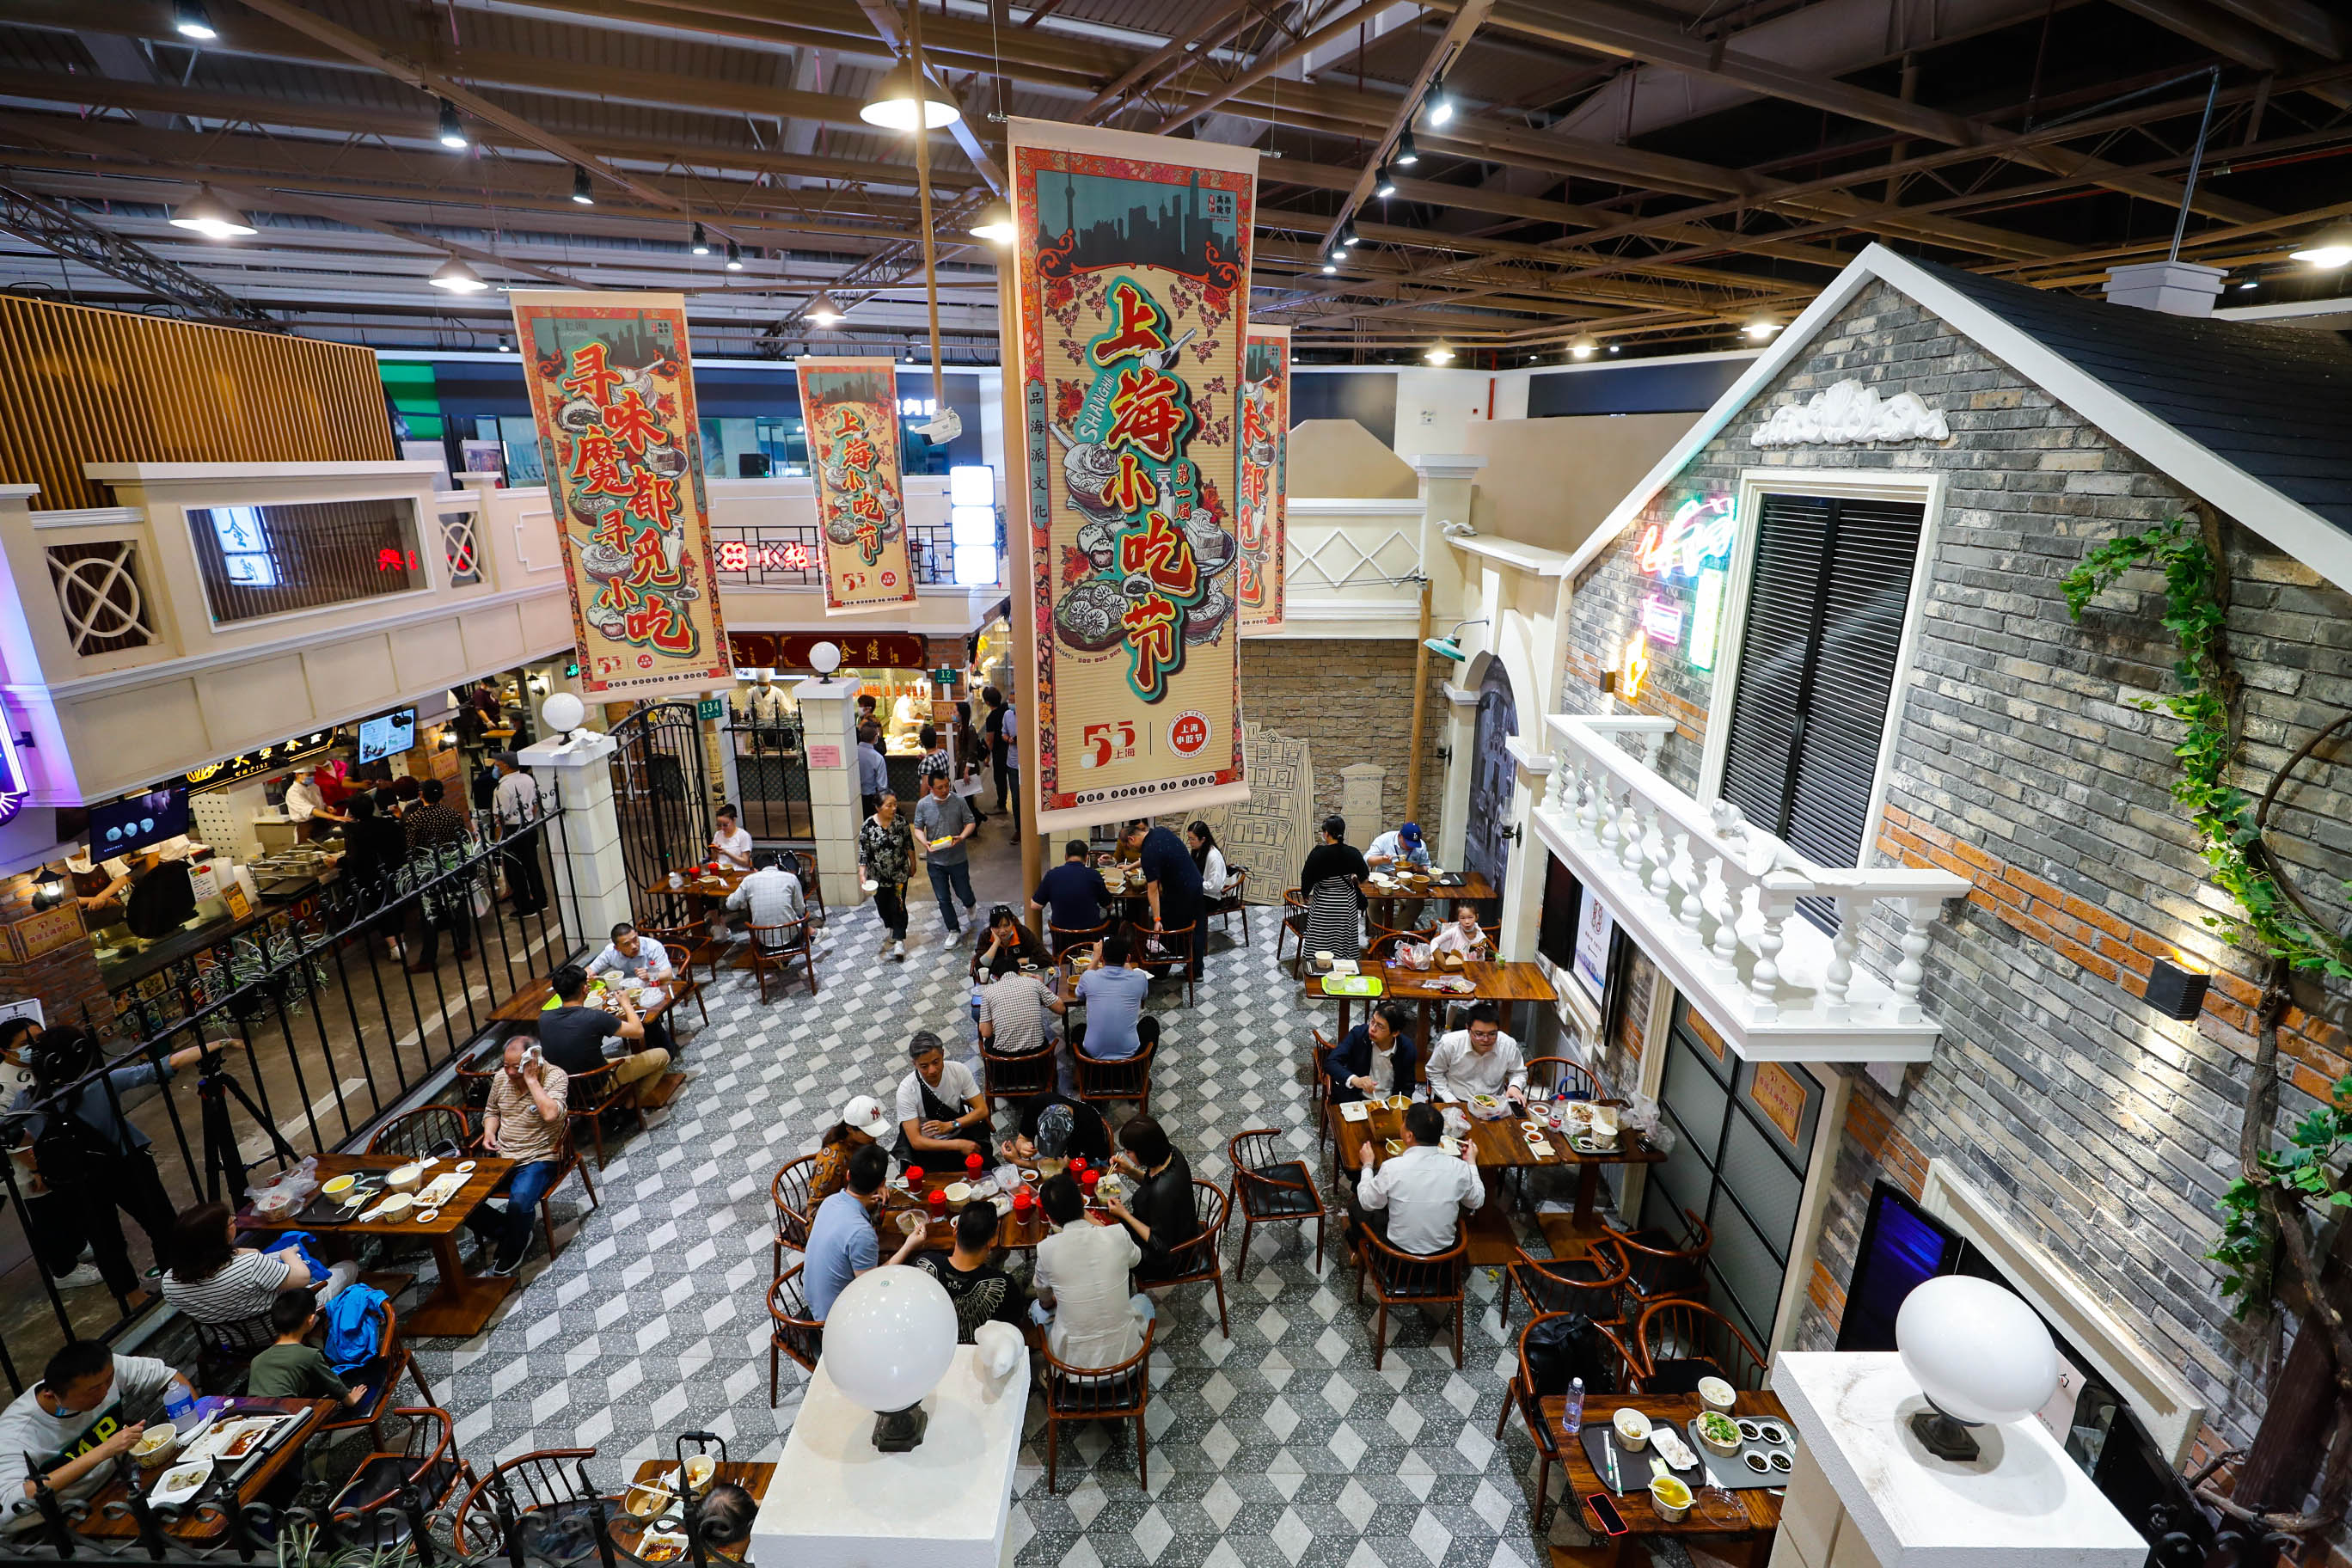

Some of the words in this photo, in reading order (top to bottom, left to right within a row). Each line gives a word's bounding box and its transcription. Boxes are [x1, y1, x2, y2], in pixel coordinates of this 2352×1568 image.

[1080, 372, 1114, 441] SHANGHAI
[1029, 392, 1048, 518] 品海派文化
[833, 409, 885, 560] 上海小吃节
[1093, 282, 1196, 692] 上海小吃节
[1174, 462, 1191, 520] 第一届
[701, 701, 720, 714] 134
[1180, 723, 1198, 733] 上海
[1176, 733, 1203, 744] 小吃节
[1077, 792, 1105, 804] THE
[1182, 775, 1215, 787] GOOD
[64, 1416, 118, 1461] AP
